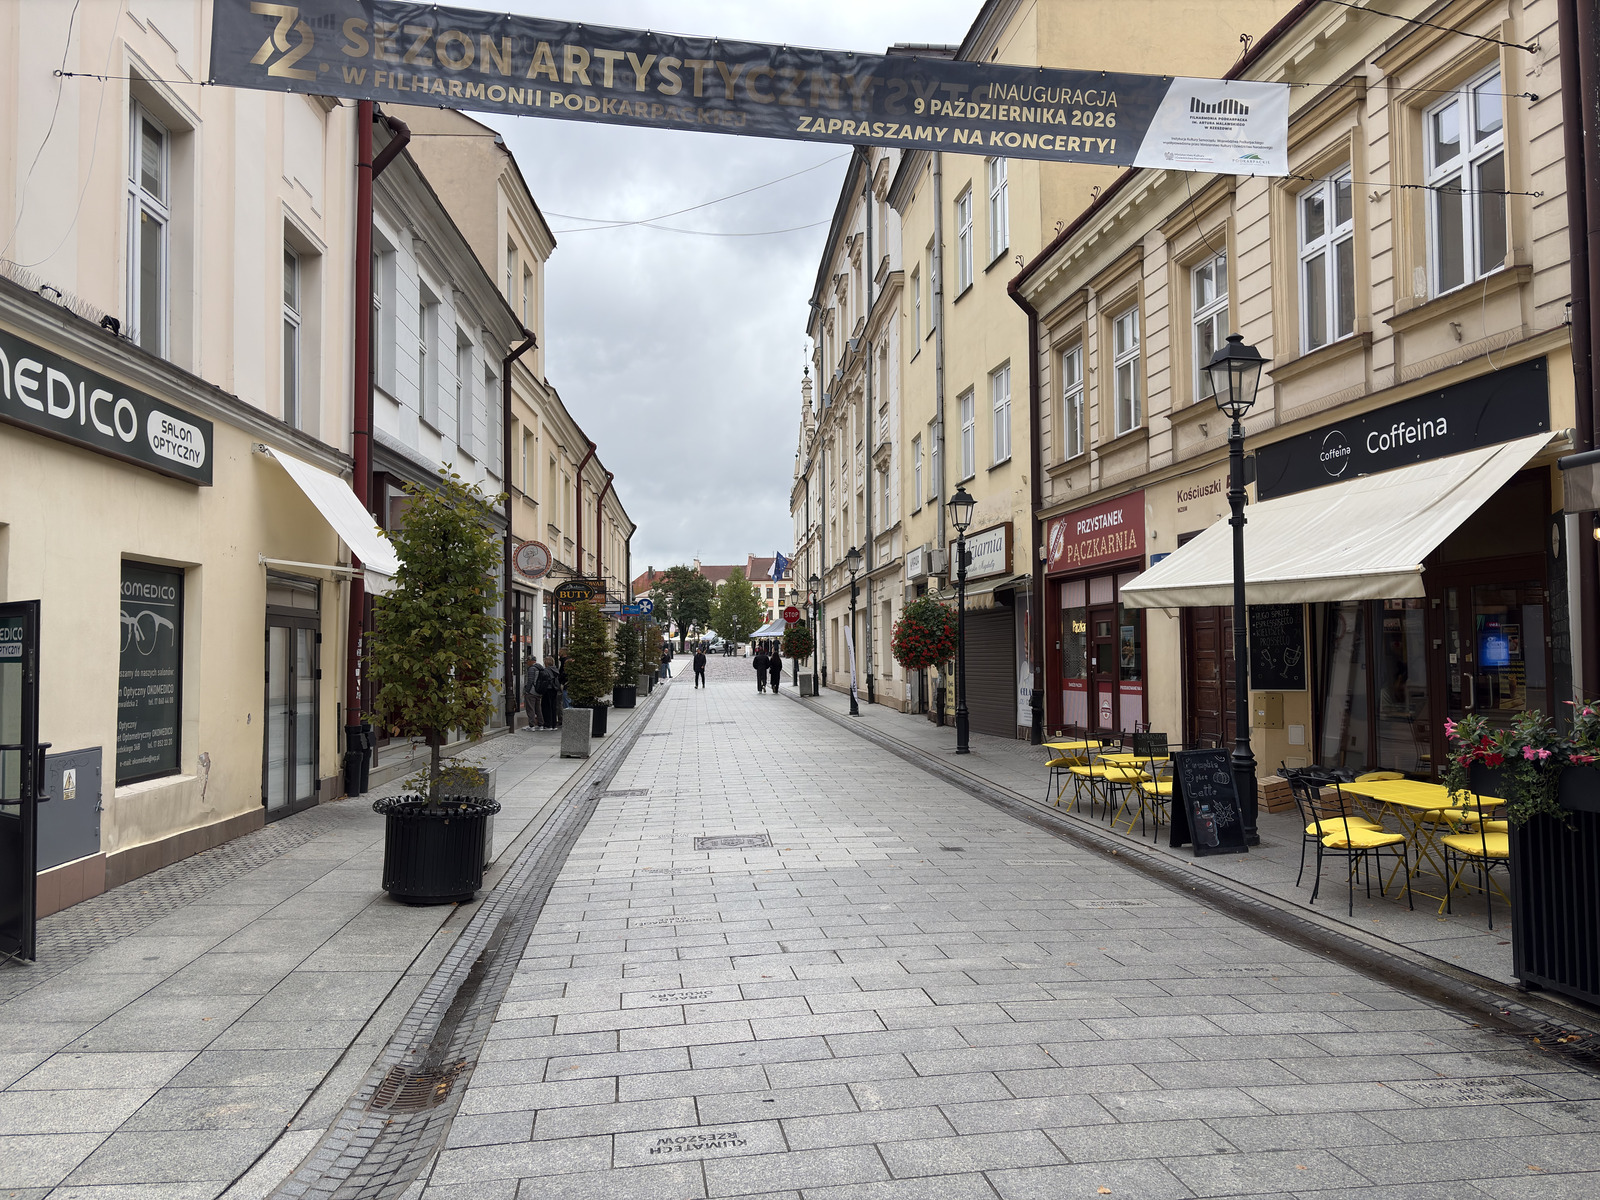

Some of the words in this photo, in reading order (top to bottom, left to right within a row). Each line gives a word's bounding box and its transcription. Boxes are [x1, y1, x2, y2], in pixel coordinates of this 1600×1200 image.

[341, 17, 512, 77] SEZON
[342, 66, 367, 86] W
[374, 70, 541, 108] FILHARMONII
[549, 91, 747, 127] PODKARPACKIEJ
[988, 82, 1118, 108] INAUGURACJA
[914, 97, 925, 115] 9
[930, 98, 1067, 126] PAŹDZIERNIKA
[1071, 110, 1117, 128] 2026
[797, 115, 949, 143] ZAPRASZAMY
[952, 128, 984, 146] NA
[989, 130, 1117, 154] KONCERTY!
[161, 420, 193, 443] SALON
[1366, 416, 1448, 454] Coffeina
[153, 435, 201, 464] OPTYCZNY
[1319, 444, 1351, 463] Coffeina
[1176, 478, 1222, 504] Kościuszki
[1077, 509, 1124, 535] PRZYSTANEK
[1067, 529, 1137, 565] PĄCZKARNIA
[560, 590, 591, 599] BUTY
[1183, 757, 1219, 771] Pumpkin
[1184, 769, 1209, 783] Spice
[1187, 782, 1218, 798] Latte
[650, 990, 713, 999] OKULARY
[659, 994, 708, 1002] DRACO
[649, 1138, 748, 1155] KLIMATECH
